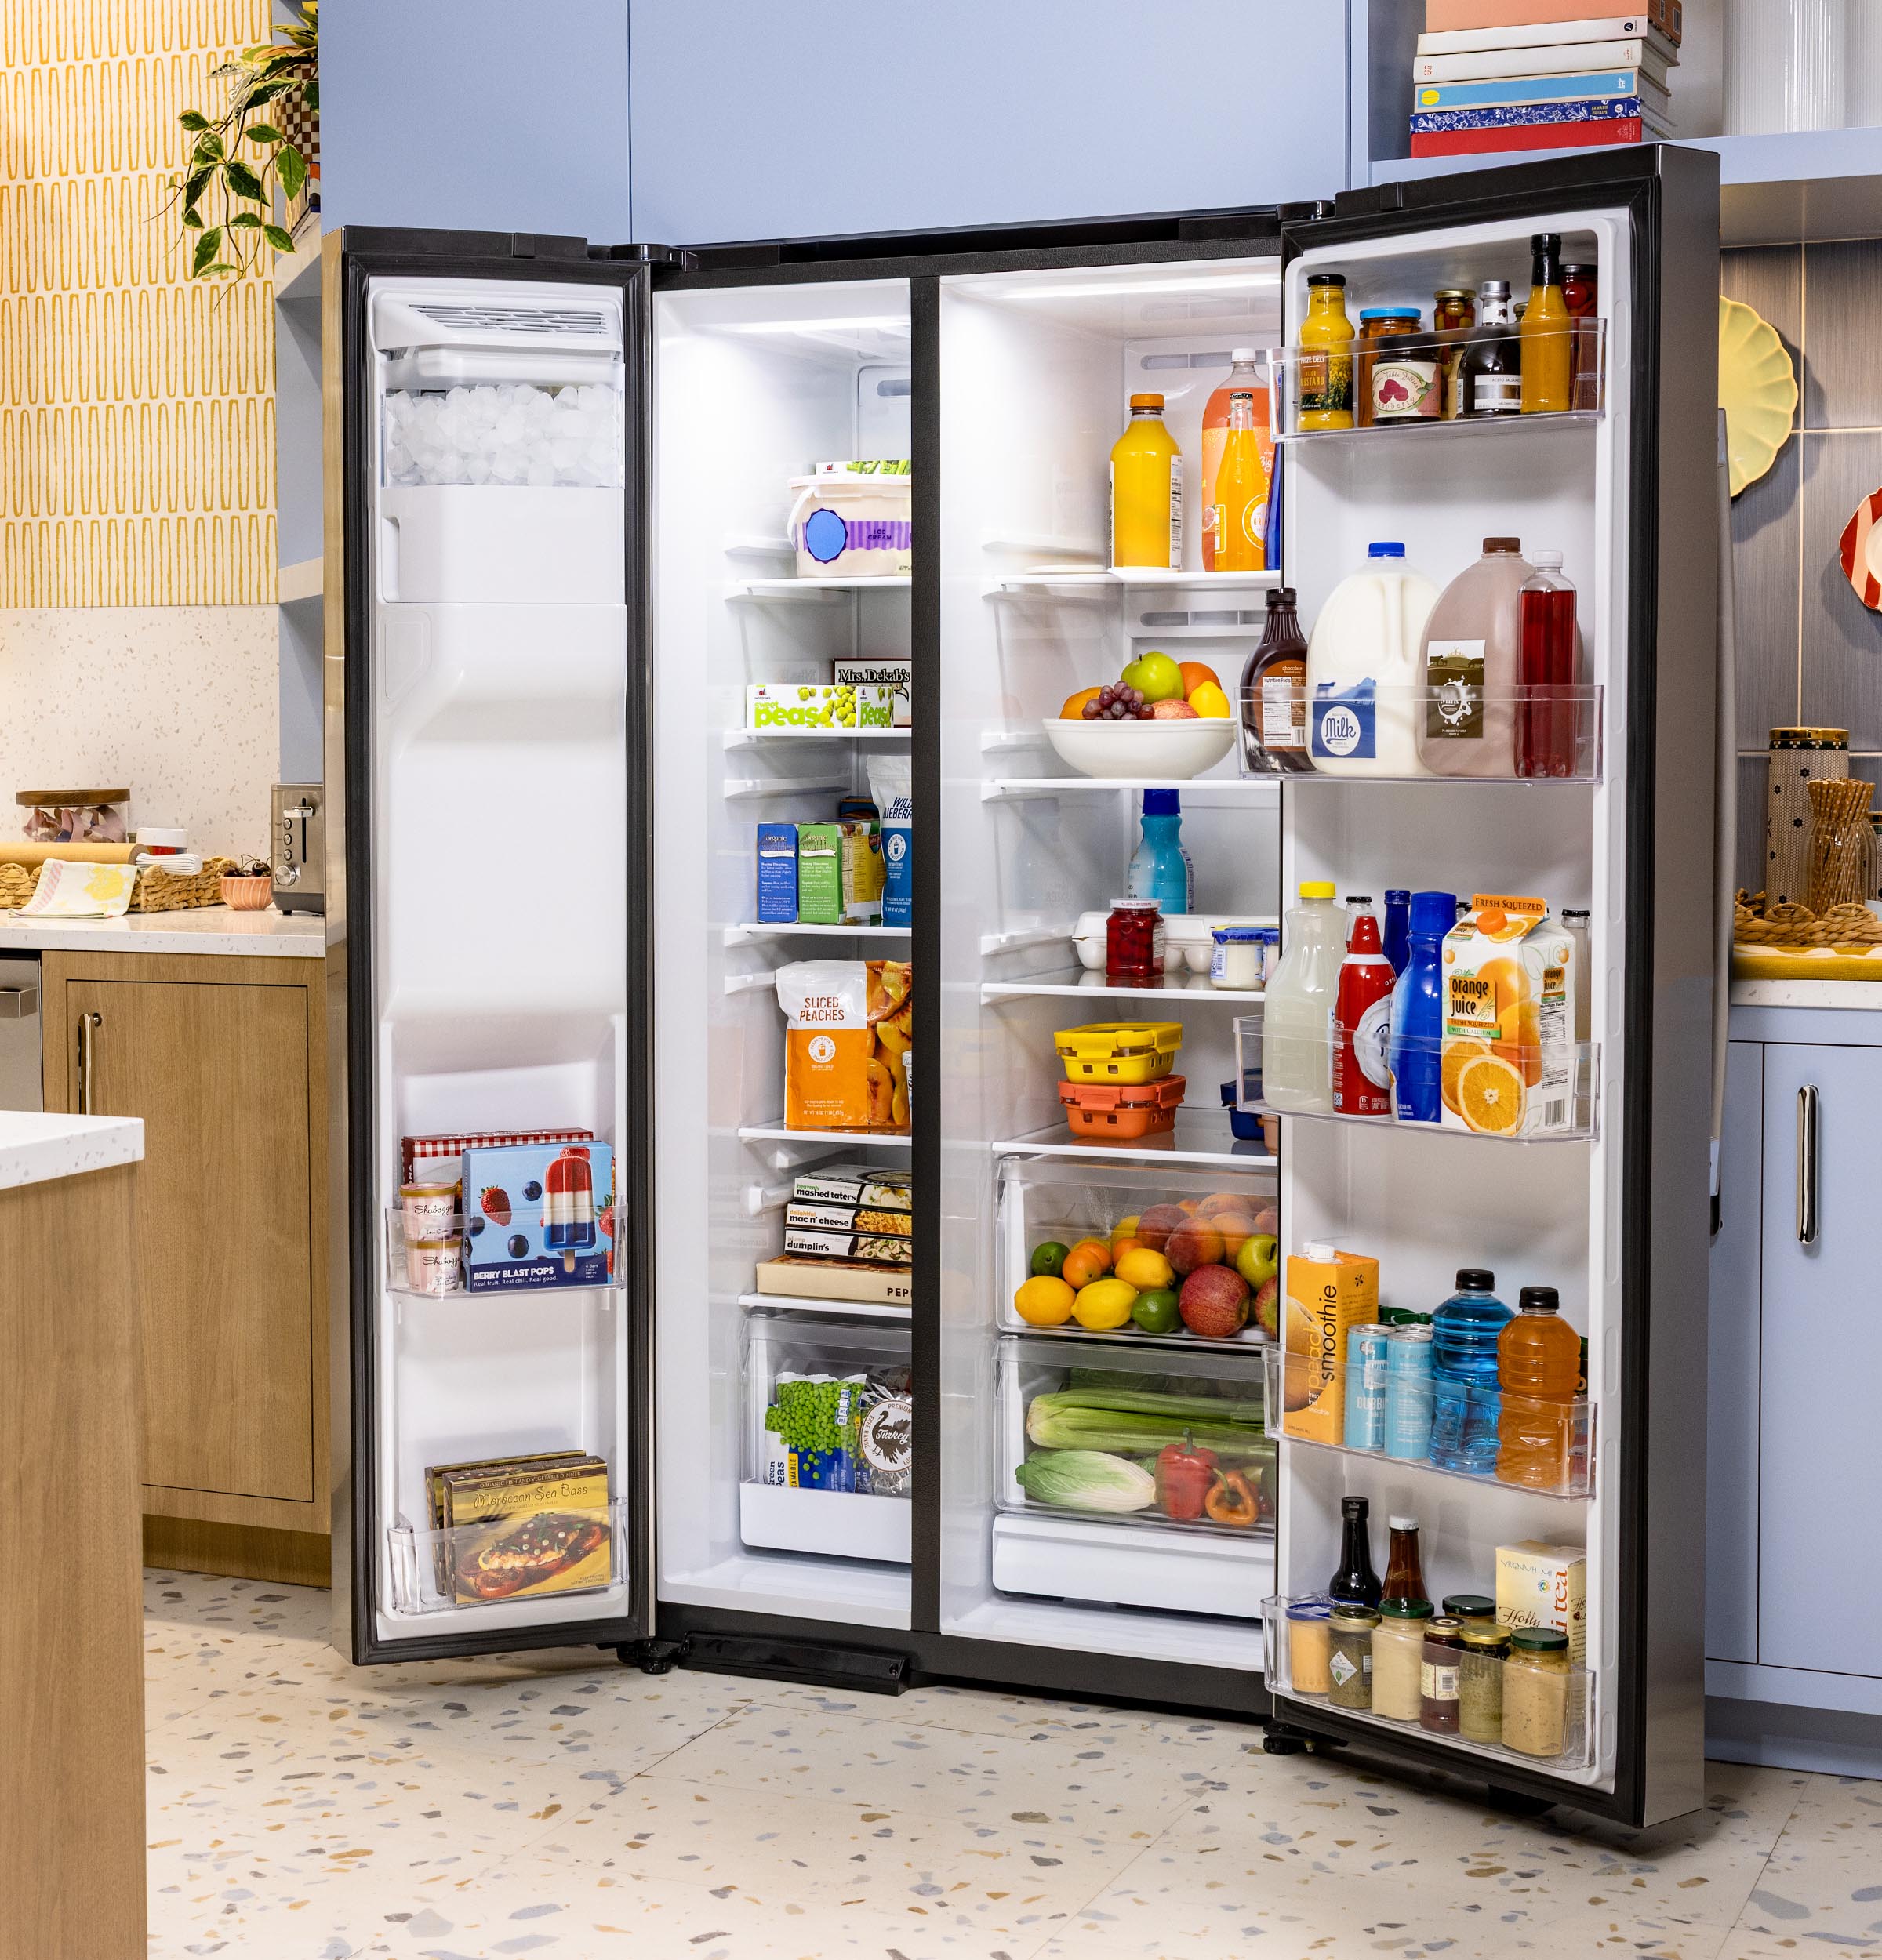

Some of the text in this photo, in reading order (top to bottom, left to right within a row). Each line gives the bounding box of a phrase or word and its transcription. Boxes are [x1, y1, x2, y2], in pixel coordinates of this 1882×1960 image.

[838, 669, 864, 683] Mrs.
[754, 700, 779, 710] sweet
[754, 706, 819, 728] peas
[1325, 717, 1357, 739] Milk
[1475, 898, 1542, 911] FRESH SQUEEZED
[1452, 978, 1488, 999] orange
[805, 996, 839, 1009] SLICED
[1451, 994, 1476, 1017] juice
[799, 1009, 845, 1022] PEACHES
[1467, 1020, 1495, 1029] SQUEEZED
[797, 1189, 856, 1201] mashed taters
[819, 1216, 849, 1227] cheese
[787, 1240, 830, 1252] dumplin's
[474, 1266, 554, 1280] BERRY BLAST POPS
[887, 1287, 912, 1298] PEP
[1316, 1284, 1337, 1382] smoothie
[1303, 1322, 1324, 1392] peach
[1308, 1390, 1320, 1399] fresh
[888, 1403, 912, 1414] PREMIU
[866, 1415, 874, 1430] FREE
[875, 1428, 910, 1445] Turkey
[531, 1473, 559, 1483] VEGETABLE
[560, 1471, 582, 1479] DINNER
[474, 1482, 587, 1508] Moroccan Sea Bass
[1553, 1567, 1568, 1613] tea
[1497, 1606, 1542, 1626] Holly
